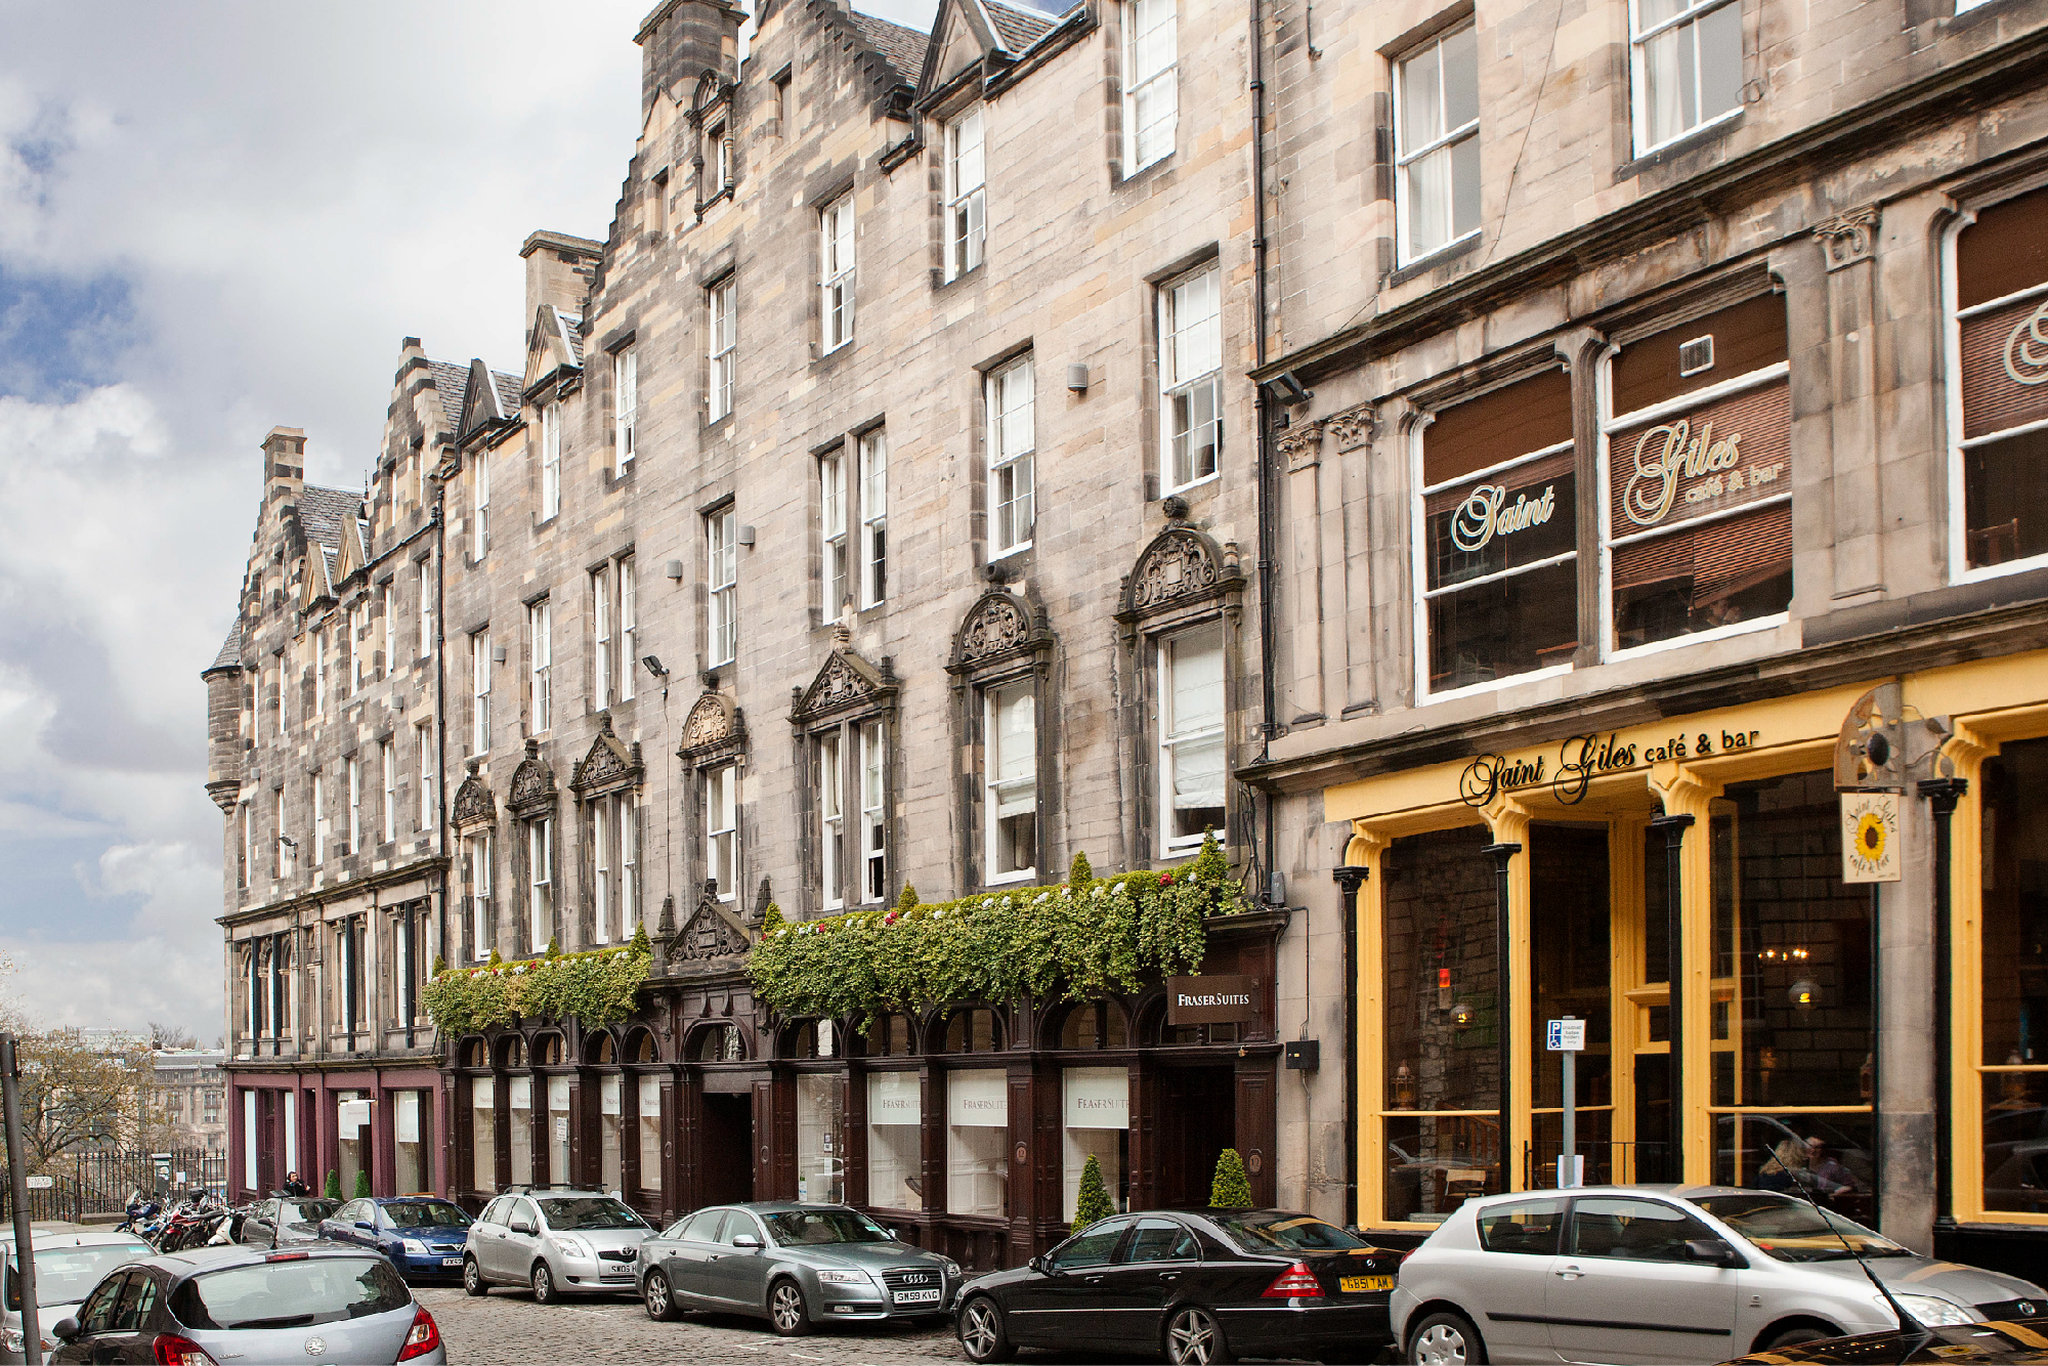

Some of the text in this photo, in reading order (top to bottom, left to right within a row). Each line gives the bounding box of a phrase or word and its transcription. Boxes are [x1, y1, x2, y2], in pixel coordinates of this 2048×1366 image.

[1624, 419, 1742, 525] Giles
[1685, 463, 1784, 503] café & bar
[1451, 484, 1555, 552] Saint
[1460, 730, 1760, 807] Saint Giles café & bar
